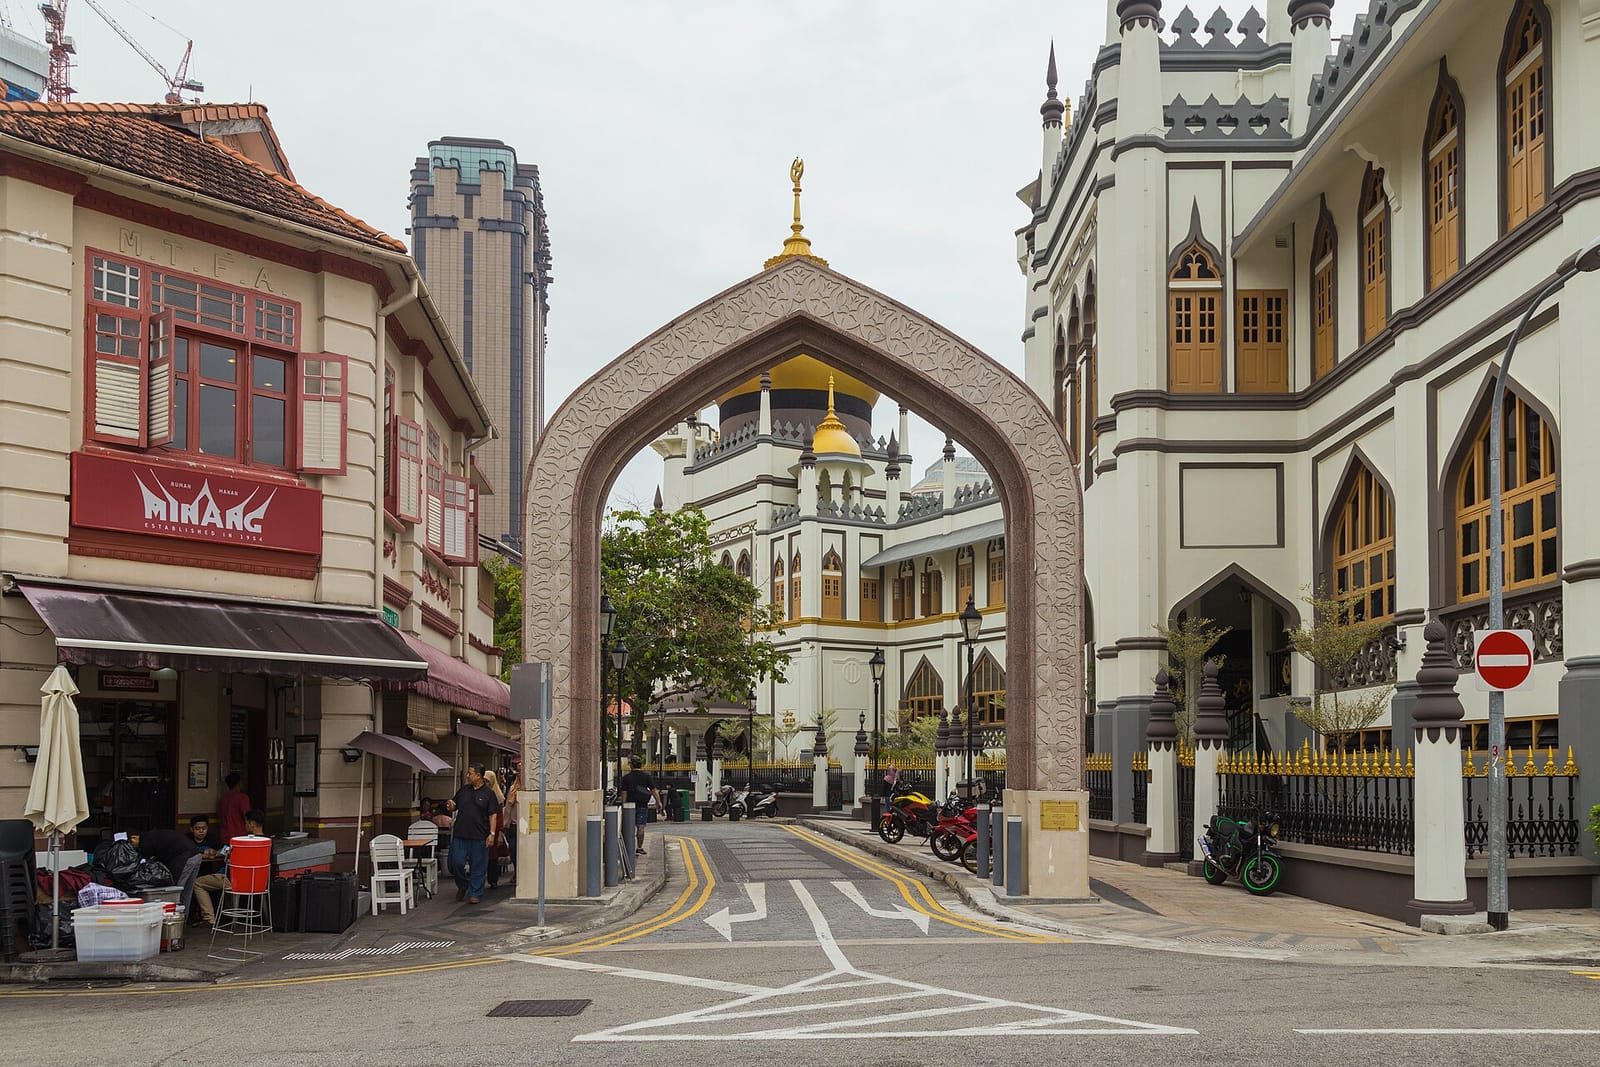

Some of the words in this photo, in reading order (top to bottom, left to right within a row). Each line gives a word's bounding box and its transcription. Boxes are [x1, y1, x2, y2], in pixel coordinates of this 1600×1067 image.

[170, 481, 192, 489] RUMAH
[218, 488, 239, 496] MAKAN
[131, 468, 277, 533] MINANG
[144, 522, 216, 537] ESTABLISHED
